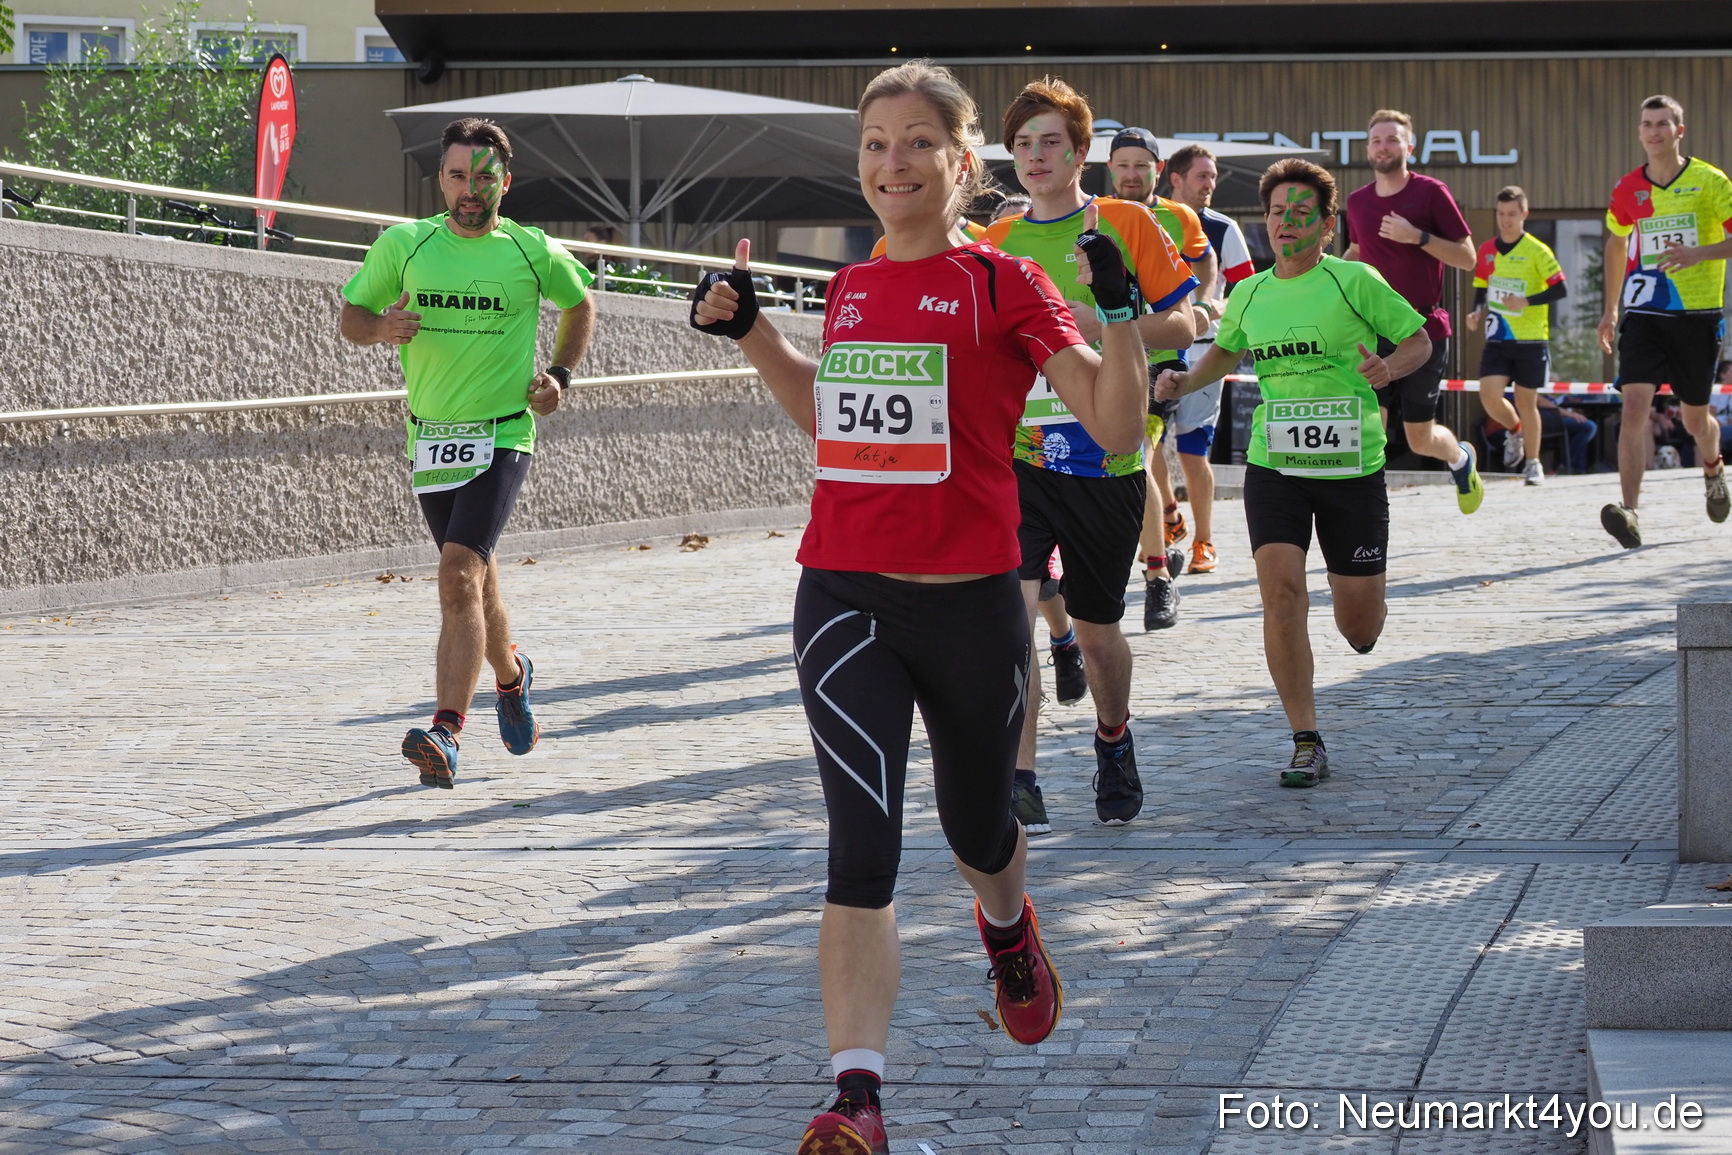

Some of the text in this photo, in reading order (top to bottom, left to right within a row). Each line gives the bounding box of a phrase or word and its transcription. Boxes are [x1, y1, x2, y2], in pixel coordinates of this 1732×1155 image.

[1643, 216, 1692, 232] BOCK
[1630, 279, 1646, 304] 7
[417, 293, 504, 311] BRANDL
[918, 295, 959, 315] Kat
[1249, 341, 1323, 361] RANDL
[824, 349, 933, 381] BOCK
[837, 392, 913, 435] 549
[1051, 402, 1070, 413] NI
[1273, 401, 1352, 419] BOCK
[420, 422, 488, 438] BOCK
[1287, 425, 1340, 448] 184
[428, 443, 475, 464] 186
[853, 446, 897, 468] Katja
[1286, 455, 1343, 466] Marianne
[1353, 546, 1381, 559] live
